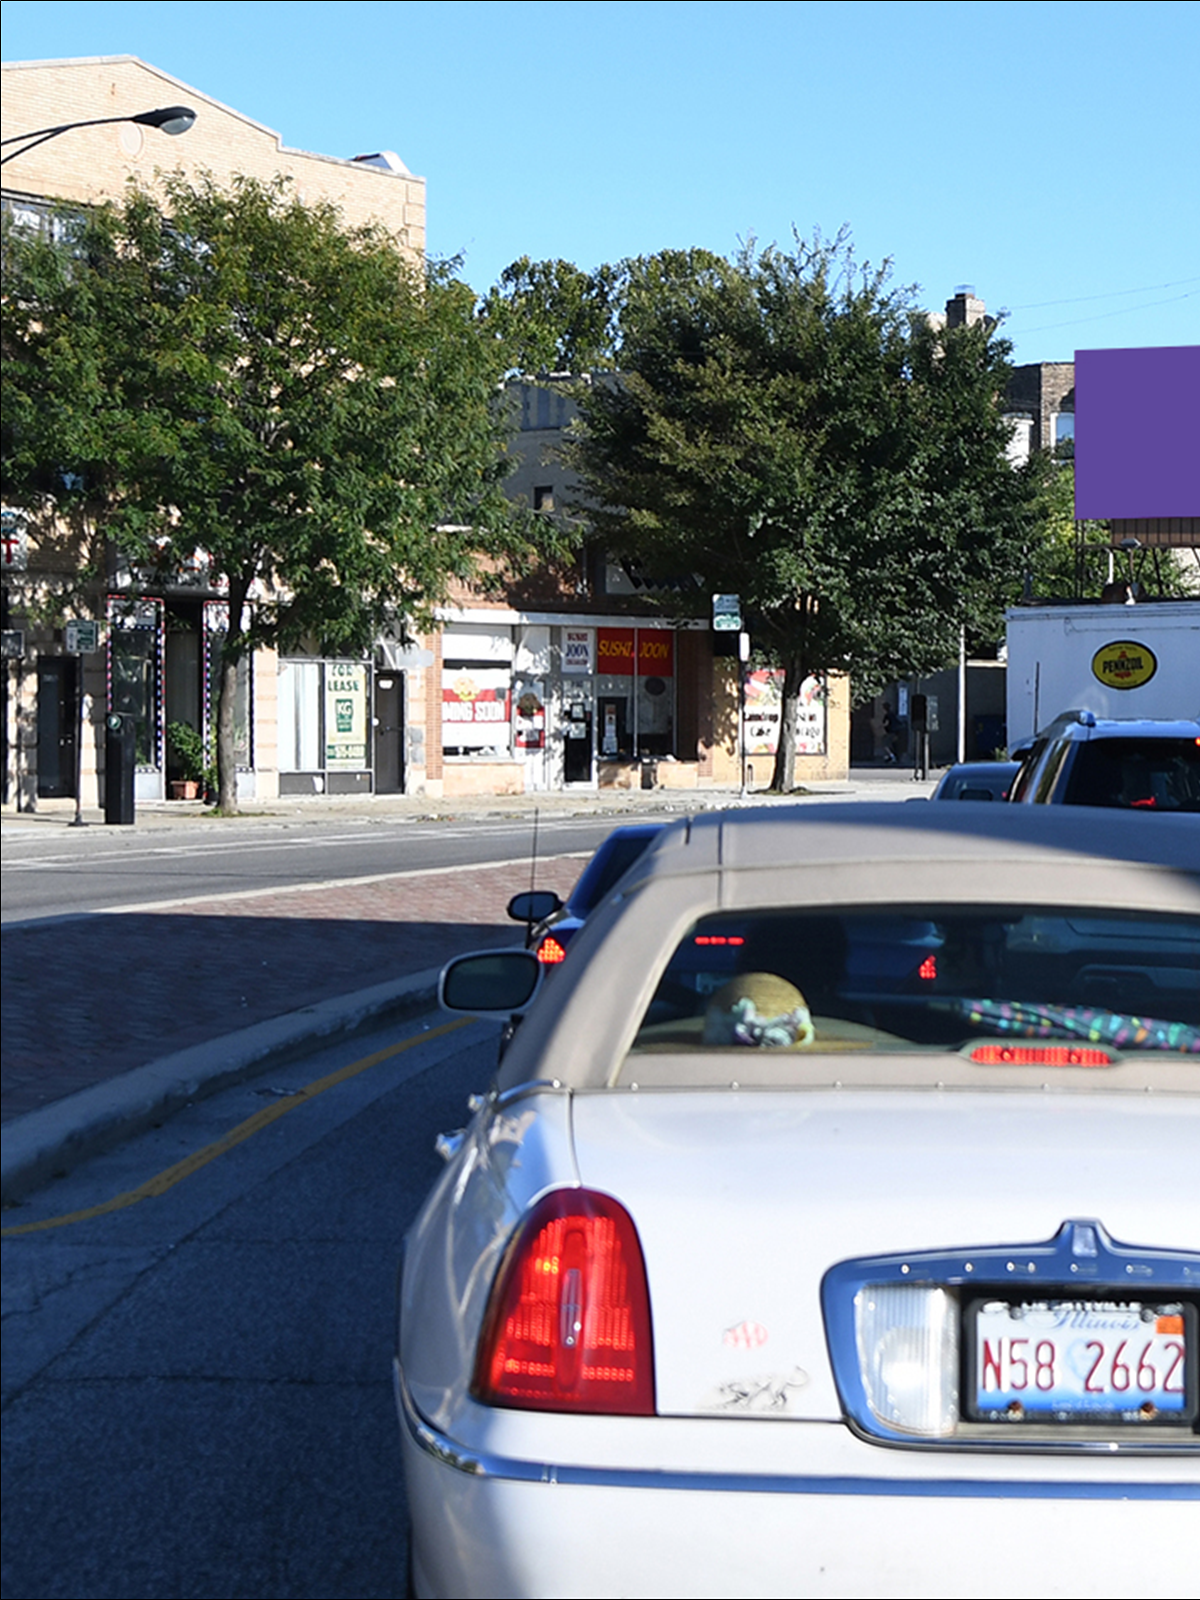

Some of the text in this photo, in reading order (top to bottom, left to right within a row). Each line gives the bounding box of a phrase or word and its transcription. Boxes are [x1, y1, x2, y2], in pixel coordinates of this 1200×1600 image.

[598, 640, 669, 658] SUSHI JOON
[328, 681, 359, 692] LEASE
[1050, 1310, 1140, 1330] Illinois
[982, 1337, 1185, 1393] N58 2662
